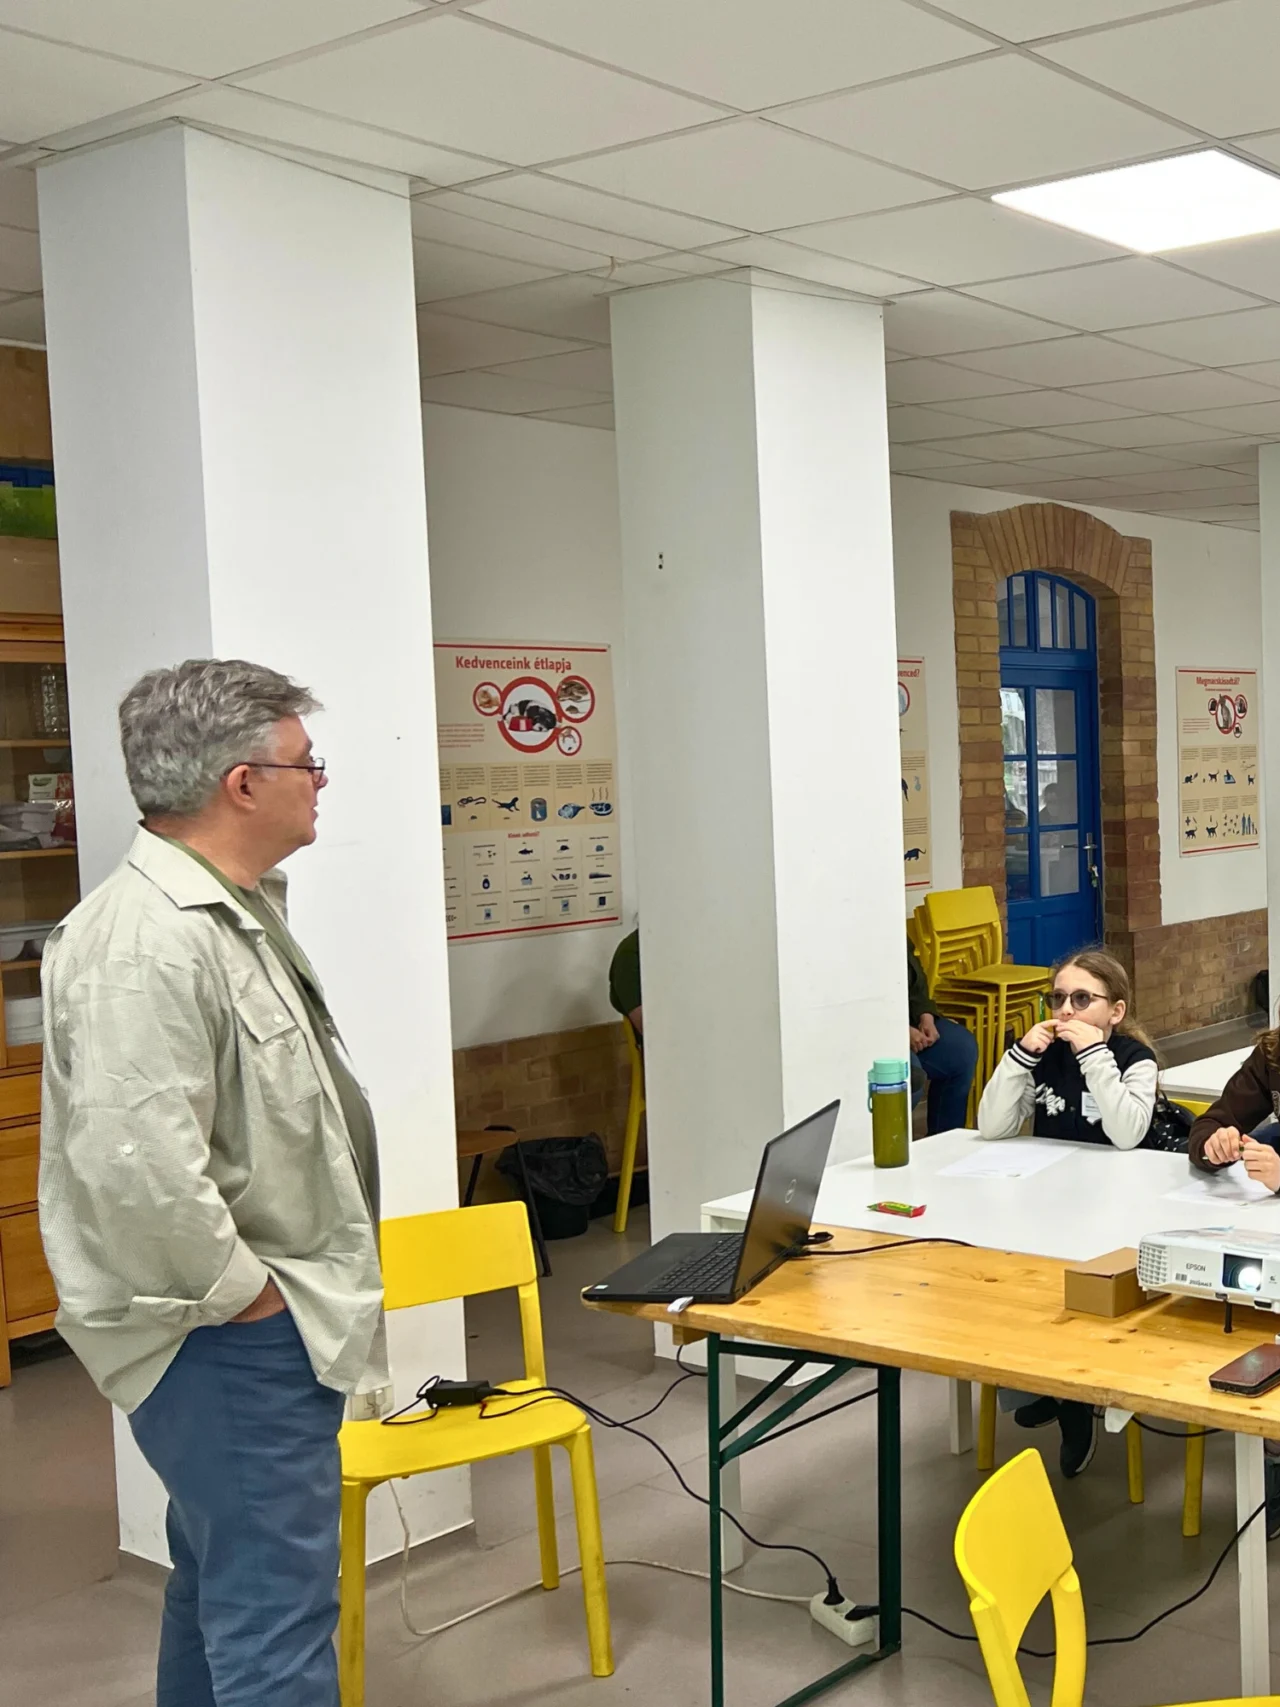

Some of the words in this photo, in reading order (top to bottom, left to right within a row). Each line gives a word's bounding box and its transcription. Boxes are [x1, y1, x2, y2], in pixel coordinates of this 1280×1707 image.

[456, 656, 531, 669] Kedvenceink
[534, 658, 572, 673] étlapja
[1185, 1262, 1206, 1272] EPSON
